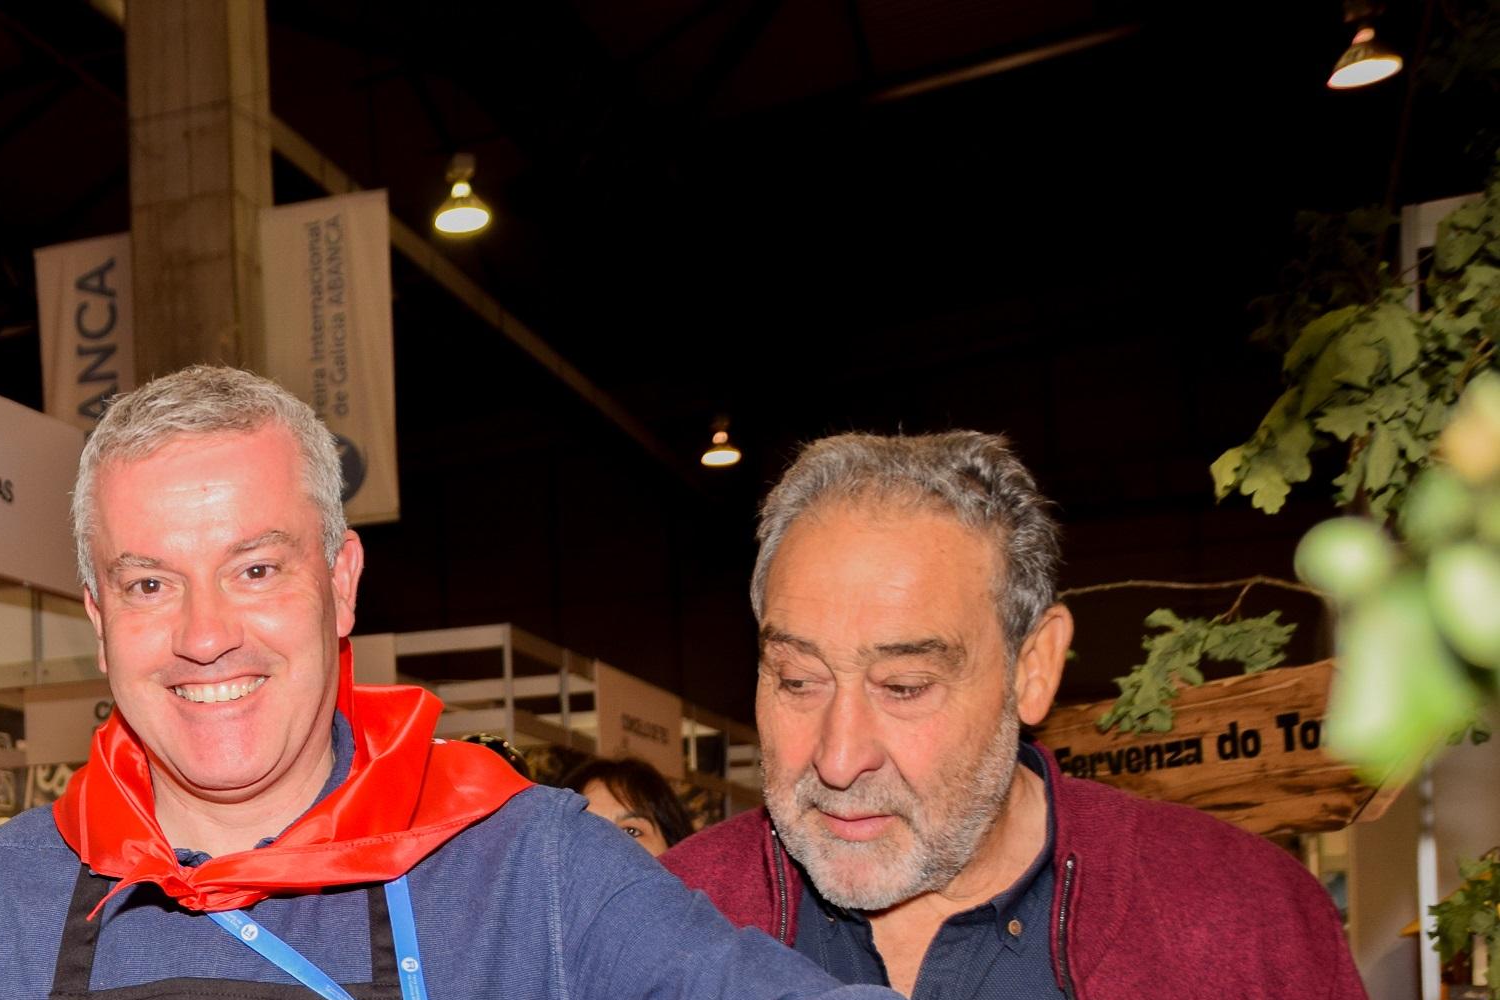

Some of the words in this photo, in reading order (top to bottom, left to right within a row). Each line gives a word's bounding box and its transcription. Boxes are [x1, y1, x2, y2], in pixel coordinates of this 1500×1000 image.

[305, 220, 325, 364] Internacional
[324, 214, 346, 306] ABANCA
[75, 257, 118, 442] ANCA
[328, 311, 348, 386] Galicia
[333, 390, 349, 417] de
[1054, 736, 1203, 779] Fervenza
[1216, 721, 1261, 761] do
[1275, 711, 1325, 752] To
